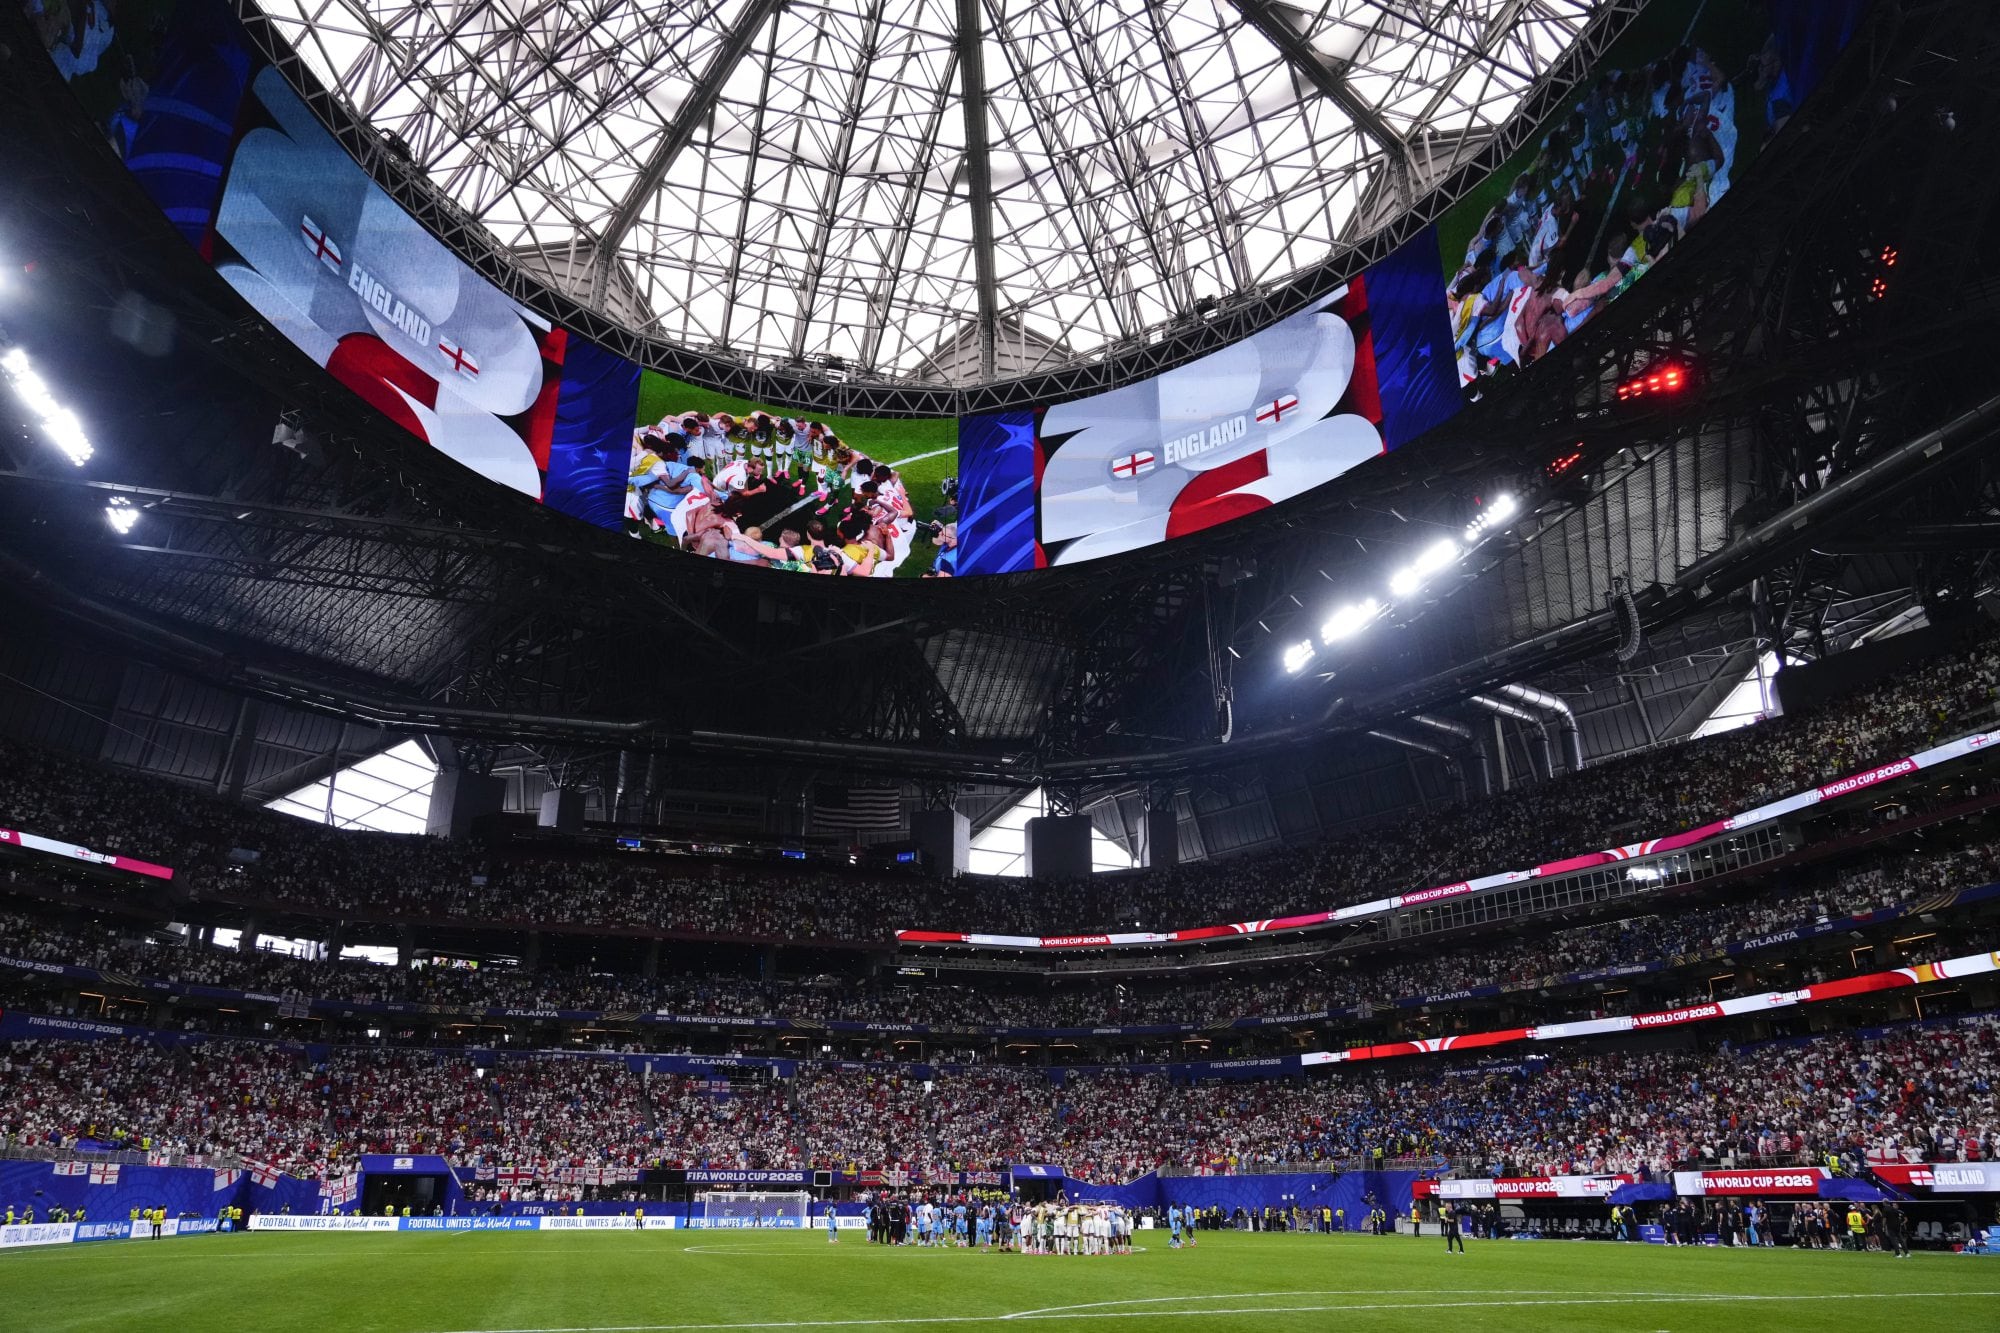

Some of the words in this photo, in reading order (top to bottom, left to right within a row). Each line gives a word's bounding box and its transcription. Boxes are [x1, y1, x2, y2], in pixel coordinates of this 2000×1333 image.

[348, 262, 431, 347] ENGLAND
[1164, 415, 1247, 465] ENGLAND
[1804, 791, 1824, 803] FIFA
[1824, 779, 1857, 797] WORLD
[1857, 772, 1877, 786] CUP
[1877, 761, 1912, 780] 2026
[90, 851, 117, 865] ENGLAND
[1518, 867, 1541, 878] ENGLAND
[1391, 895, 1405, 905] FIFA
[1405, 892, 1428, 903] WORLD
[1429, 889, 1442, 900] CUP
[1442, 884, 1467, 895] 2026
[1030, 938, 1043, 946] FIFA
[1083, 936, 1107, 944] 2026
[1743, 930, 1799, 950] ATLANTA
[16, 960, 33, 969] CUP
[33, 963, 64, 974] 2026
[1425, 990, 1472, 1003] ATLANTA
[1782, 988, 1811, 1001] ENGLAND
[505, 1009, 559, 1018] ATLANTA
[1276, 1015, 1298, 1023] WORLD
[1298, 1013, 1309, 1021] CUP
[1309, 1011, 1328, 1019] 2026
[1619, 1017, 1639, 1029] FIFA
[1639, 1013, 1673, 1026] WORLD
[1674, 1011, 1689, 1022] CUP
[1689, 1006, 1717, 1018] 2026
[28, 1016, 47, 1026] FIFA
[48, 1018, 78, 1030] WORLD
[78, 1022, 95, 1032] CUP
[95, 1025, 124, 1035] 2026
[866, 1023, 913, 1031] ATLANTA
[687, 1058, 738, 1066] ATLANTA
[1210, 1061, 1223, 1069] FIFA
[1223, 1060, 1246, 1068] WORLD
[1246, 1059, 1259, 1067] CUP
[1259, 1058, 1281, 1066] 2026
[686, 1171, 709, 1181] FIFA
[710, 1172, 746, 1181] WORLD
[747, 1172, 768, 1181] CUP
[768, 1172, 804, 1182] 2026
[1695, 1178, 1715, 1189] FIFA
[1715, 1177, 1752, 1188] WORLD
[1752, 1176, 1773, 1188] CUP
[1774, 1175, 1813, 1187] 2026
[1934, 1169, 1985, 1186] ENGLAND
[1475, 1184, 1491, 1193] FIFA
[1491, 1183, 1518, 1194] WORLD
[1519, 1182, 1535, 1193] CUP
[1535, 1181, 1564, 1192] 2026
[523, 1206, 545, 1215] FIFA
[258, 1217, 297, 1227] FOOTBALL
[299, 1218, 326, 1228] UNITES
[329, 1217, 342, 1228] the
[343, 1217, 369, 1229] World
[408, 1218, 444, 1229] FOOTBALL
[446, 1218, 471, 1229] UNITES
[473, 1217, 486, 1229] the
[487, 1217, 513, 1230] World
[550, 1218, 583, 1228] FOOTBALL
[585, 1218, 609, 1228] UNITES
[611, 1217, 623, 1228] the
[779, 1219, 795, 1227] FIFA
[843, 1218, 865, 1227] UNITES
